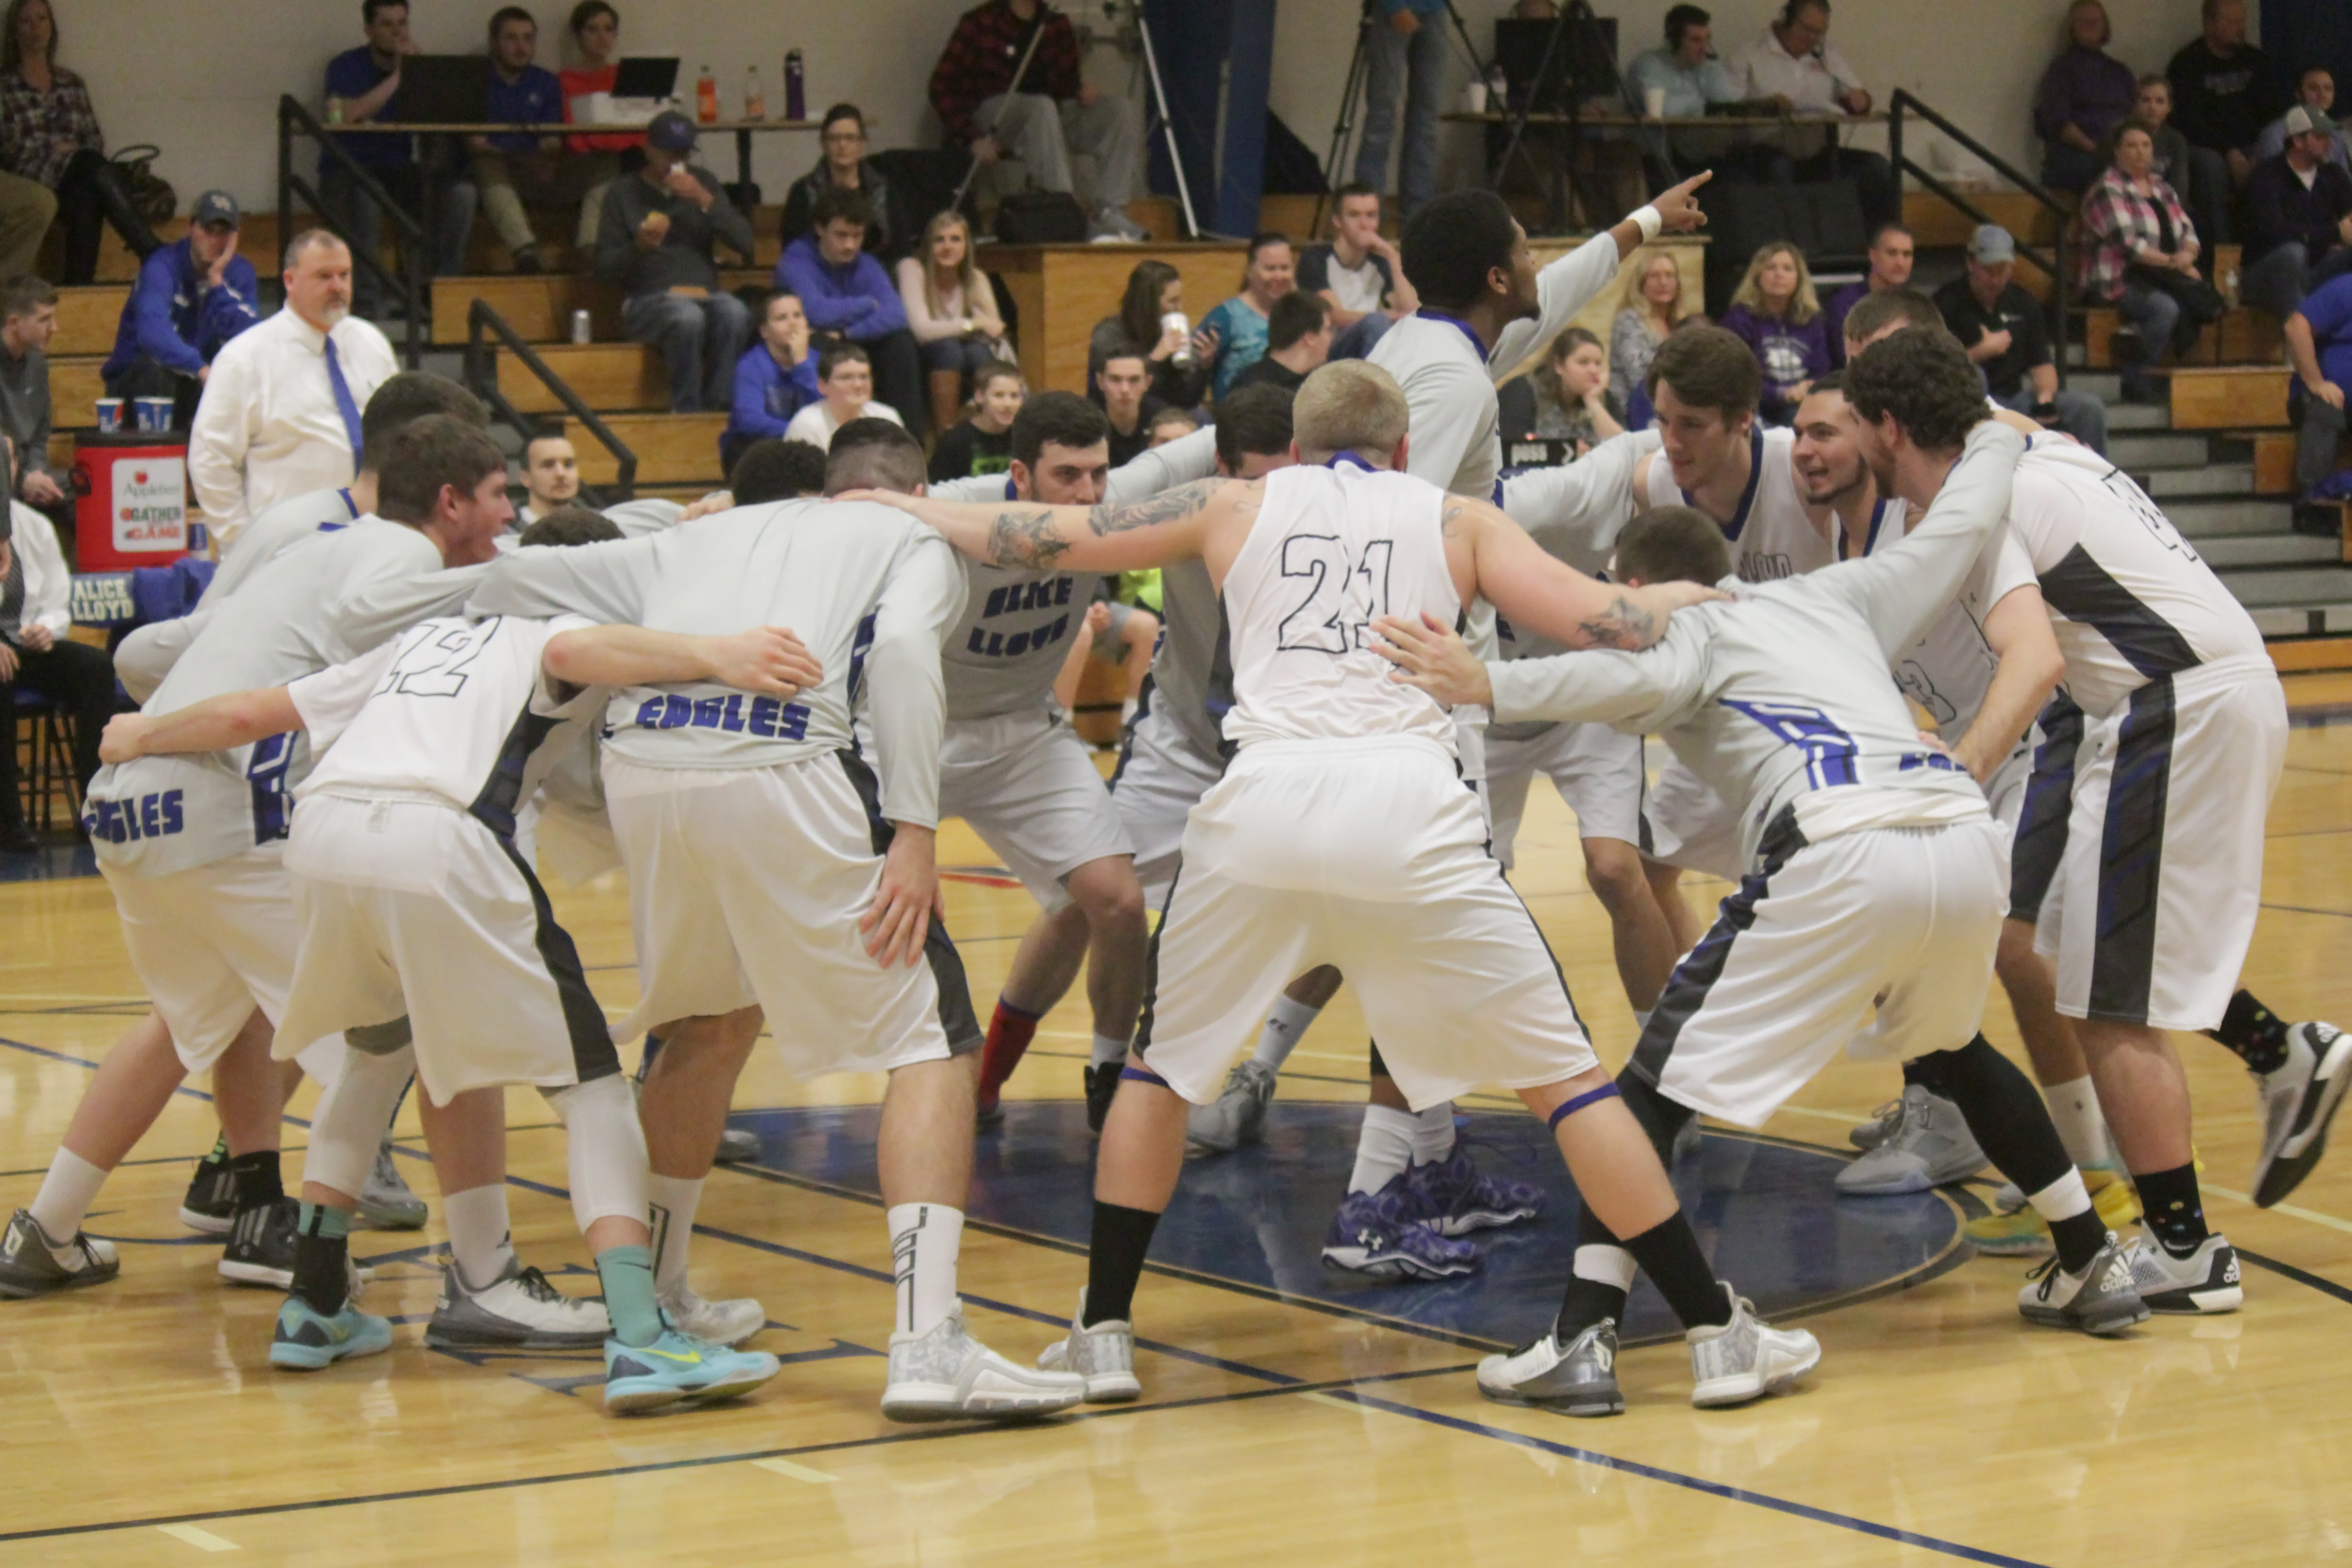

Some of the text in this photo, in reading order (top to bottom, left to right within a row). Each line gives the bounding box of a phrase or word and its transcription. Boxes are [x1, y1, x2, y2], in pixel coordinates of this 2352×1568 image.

[73, 579, 128, 600] ALICE
[1277, 534, 1402, 667] 21
[72, 599, 135, 621] LLOYD
[636, 693, 811, 741] EAGLES
